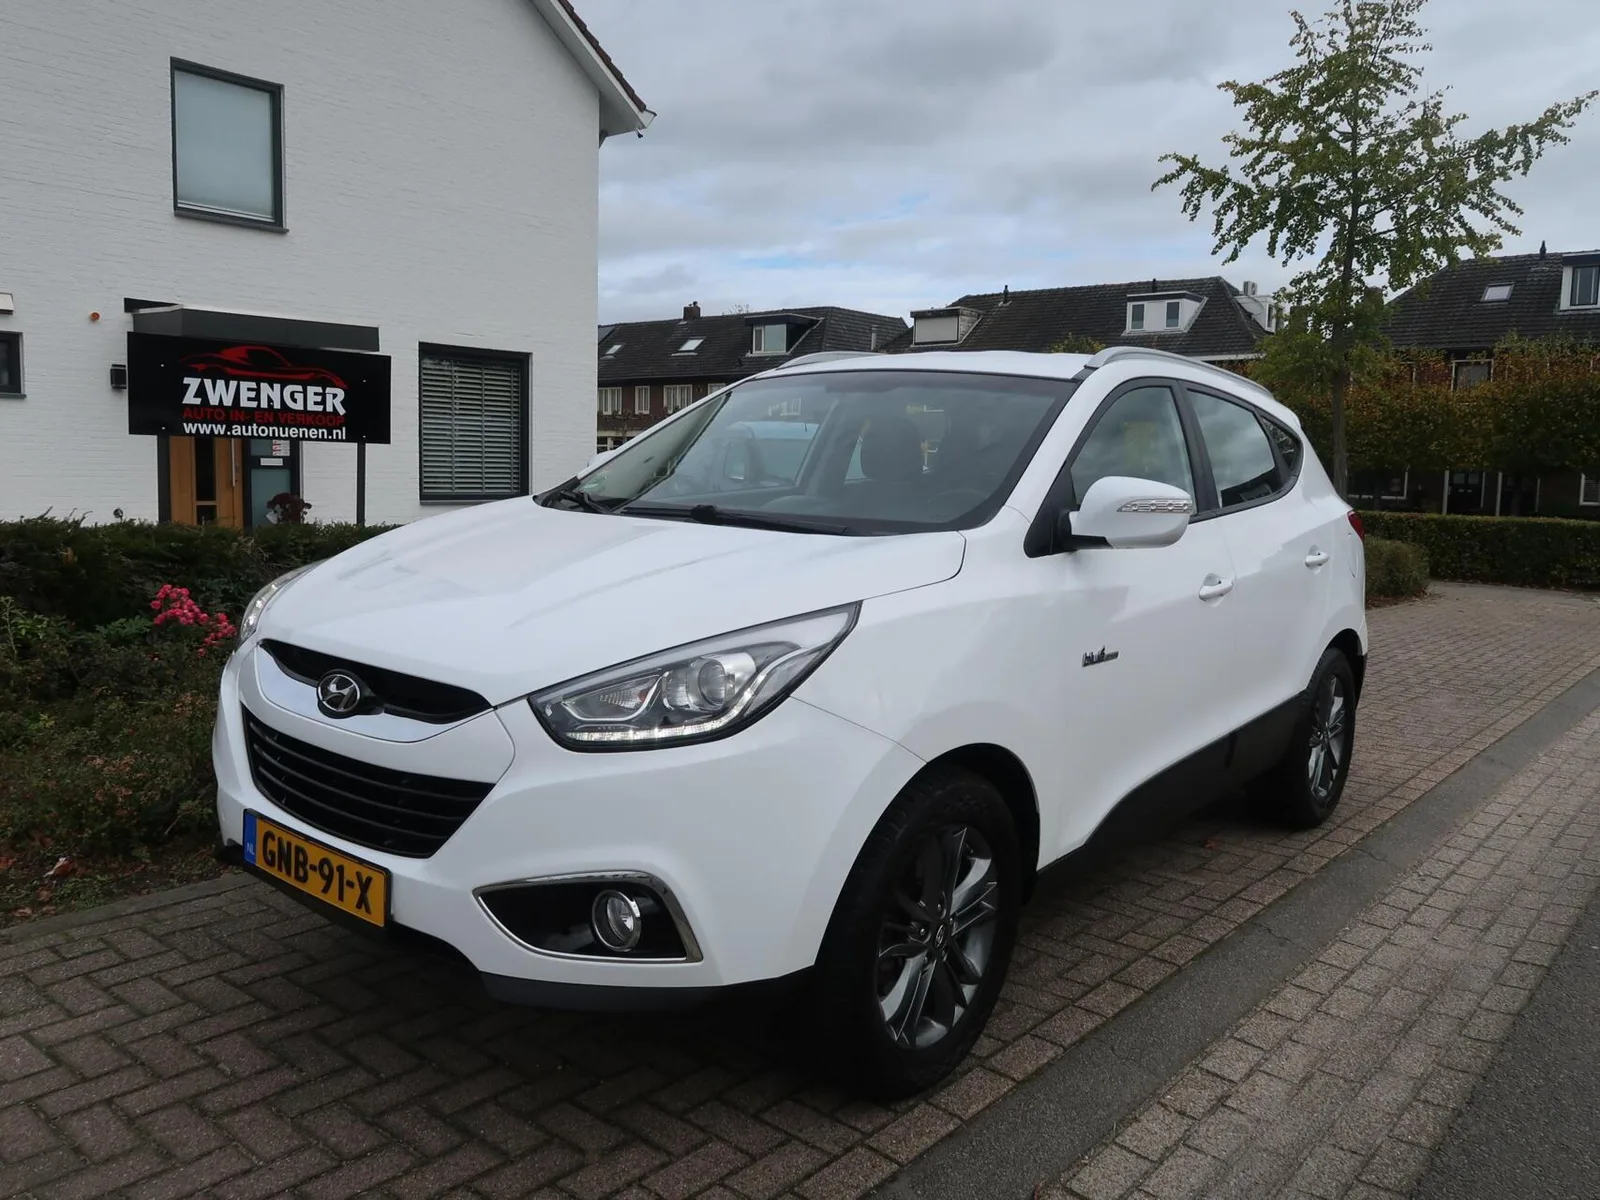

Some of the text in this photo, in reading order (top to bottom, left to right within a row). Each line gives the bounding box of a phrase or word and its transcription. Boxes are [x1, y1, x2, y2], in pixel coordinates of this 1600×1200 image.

[182, 377, 346, 415] ZWENGER
[183, 406, 226, 420] AUTO
[255, 411, 274, 424] EN
[278, 412, 345, 427] VERKOOP
[183, 422, 346, 440] www.autonuenen.nl
[262, 830, 373, 915] GNB-91-X
